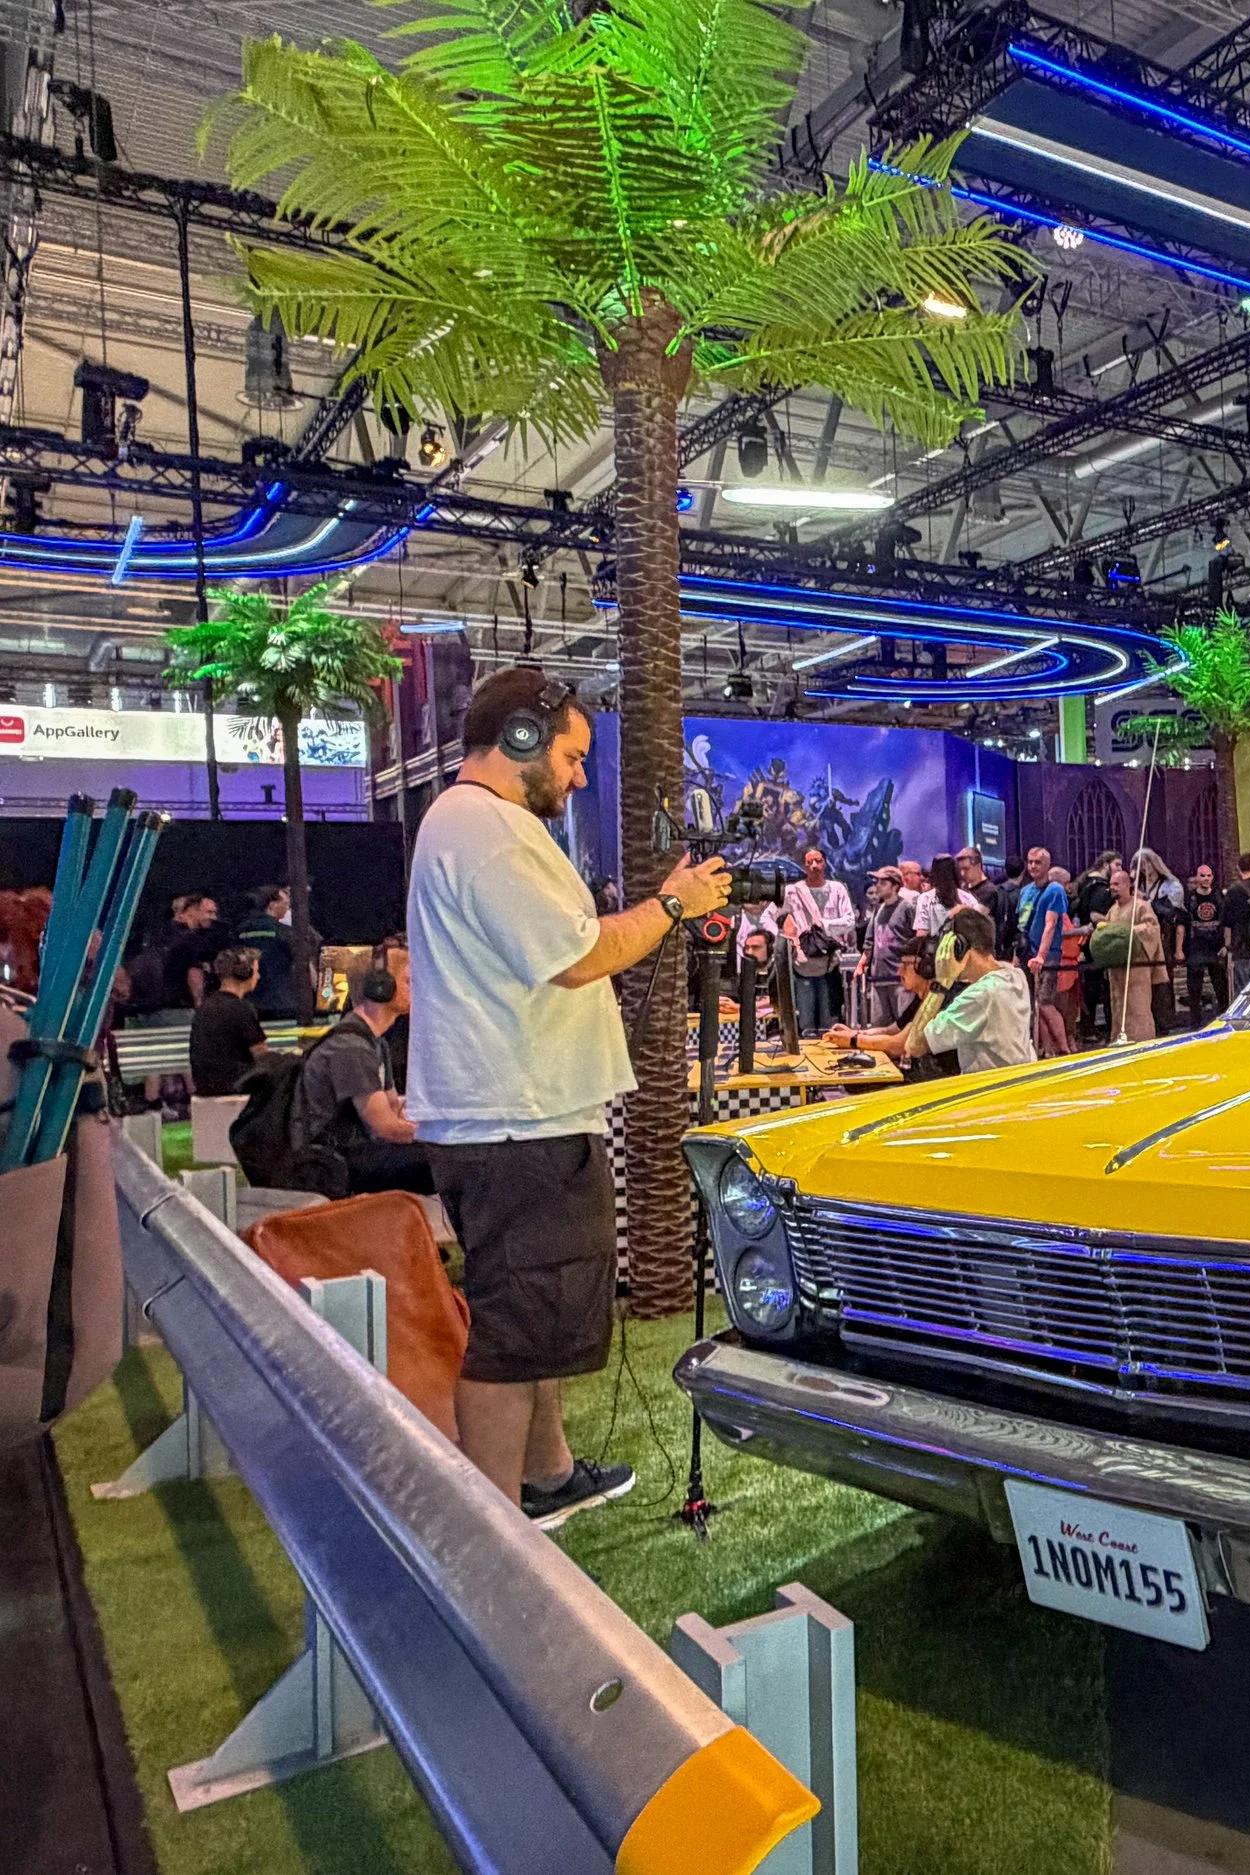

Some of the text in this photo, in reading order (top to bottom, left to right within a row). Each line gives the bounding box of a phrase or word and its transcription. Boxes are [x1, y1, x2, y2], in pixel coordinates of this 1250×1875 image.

[33, 723, 120, 742] AppGallery
[1060, 1519, 1139, 1555] West Coast
[1027, 1534, 1187, 1614] 1NOM155
